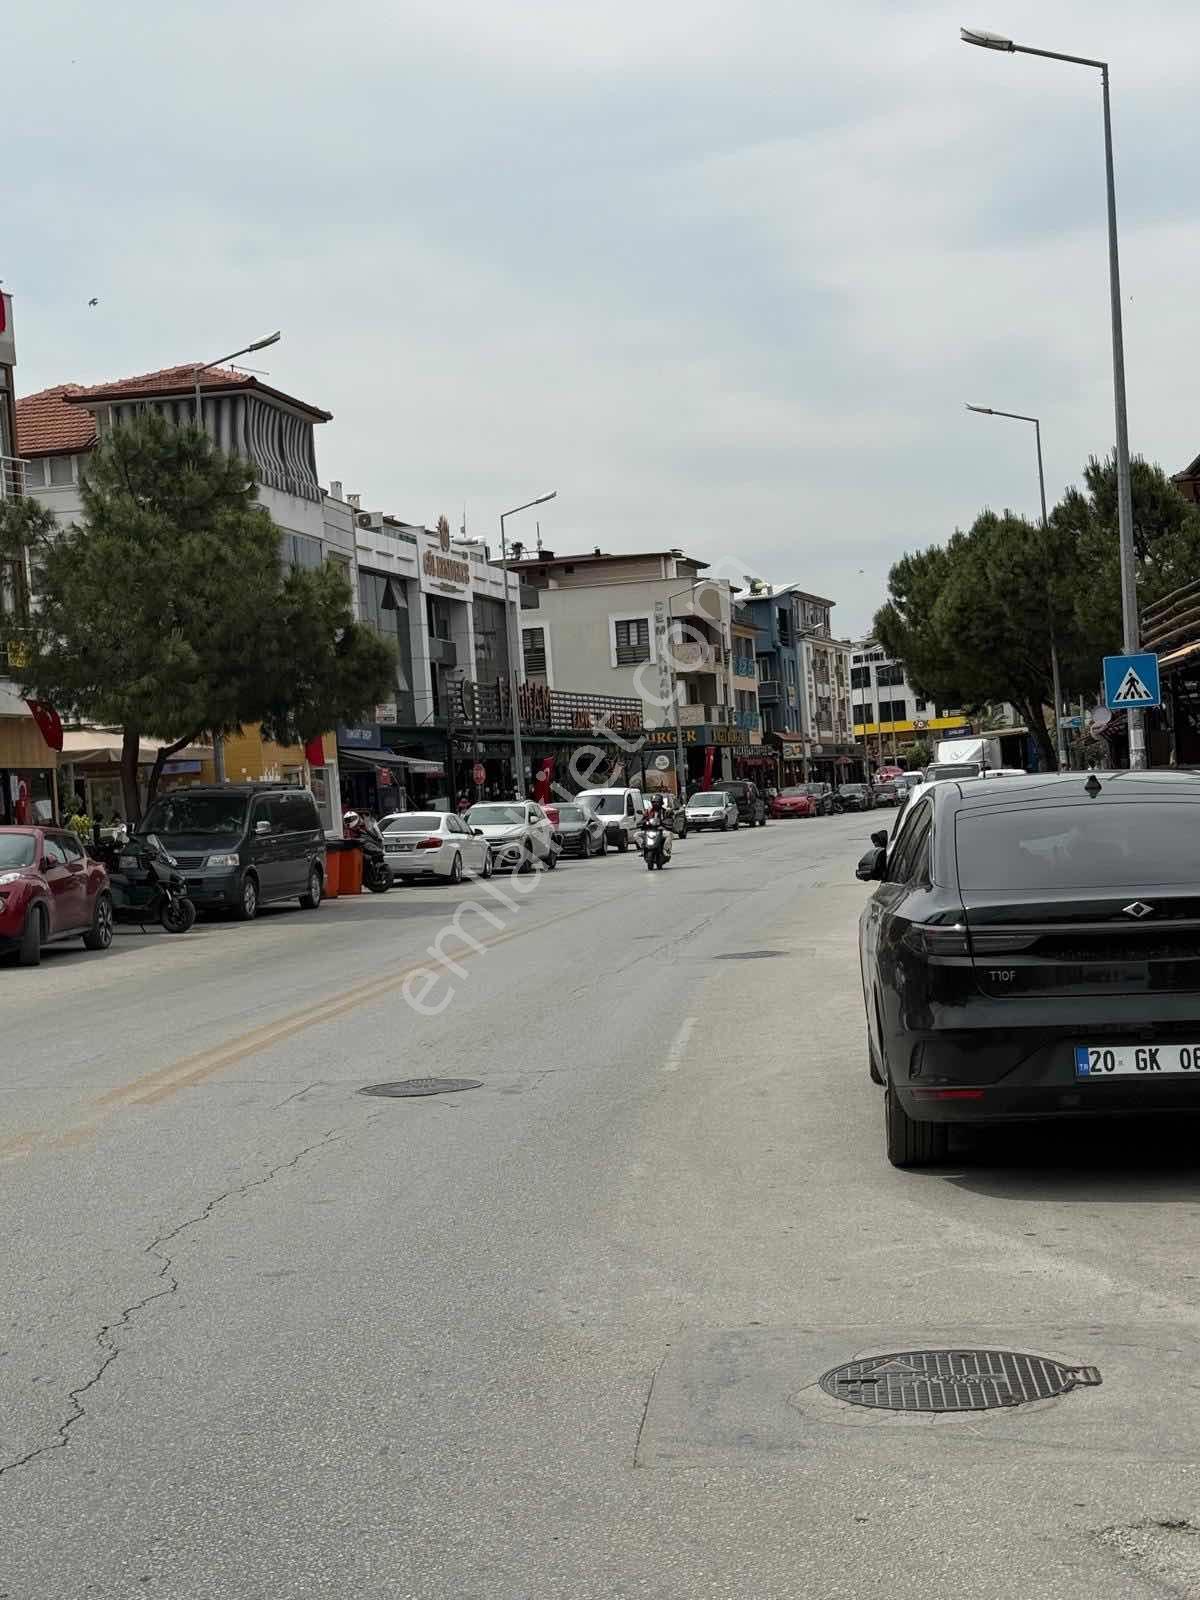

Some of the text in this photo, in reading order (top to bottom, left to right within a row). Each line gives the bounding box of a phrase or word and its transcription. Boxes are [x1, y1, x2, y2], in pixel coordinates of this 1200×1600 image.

[642, 728, 697, 744] URGER
[989, 970, 1016, 981] T10F
[1089, 1050, 1115, 1072] 20
[1135, 1048, 1161, 1071] GK
